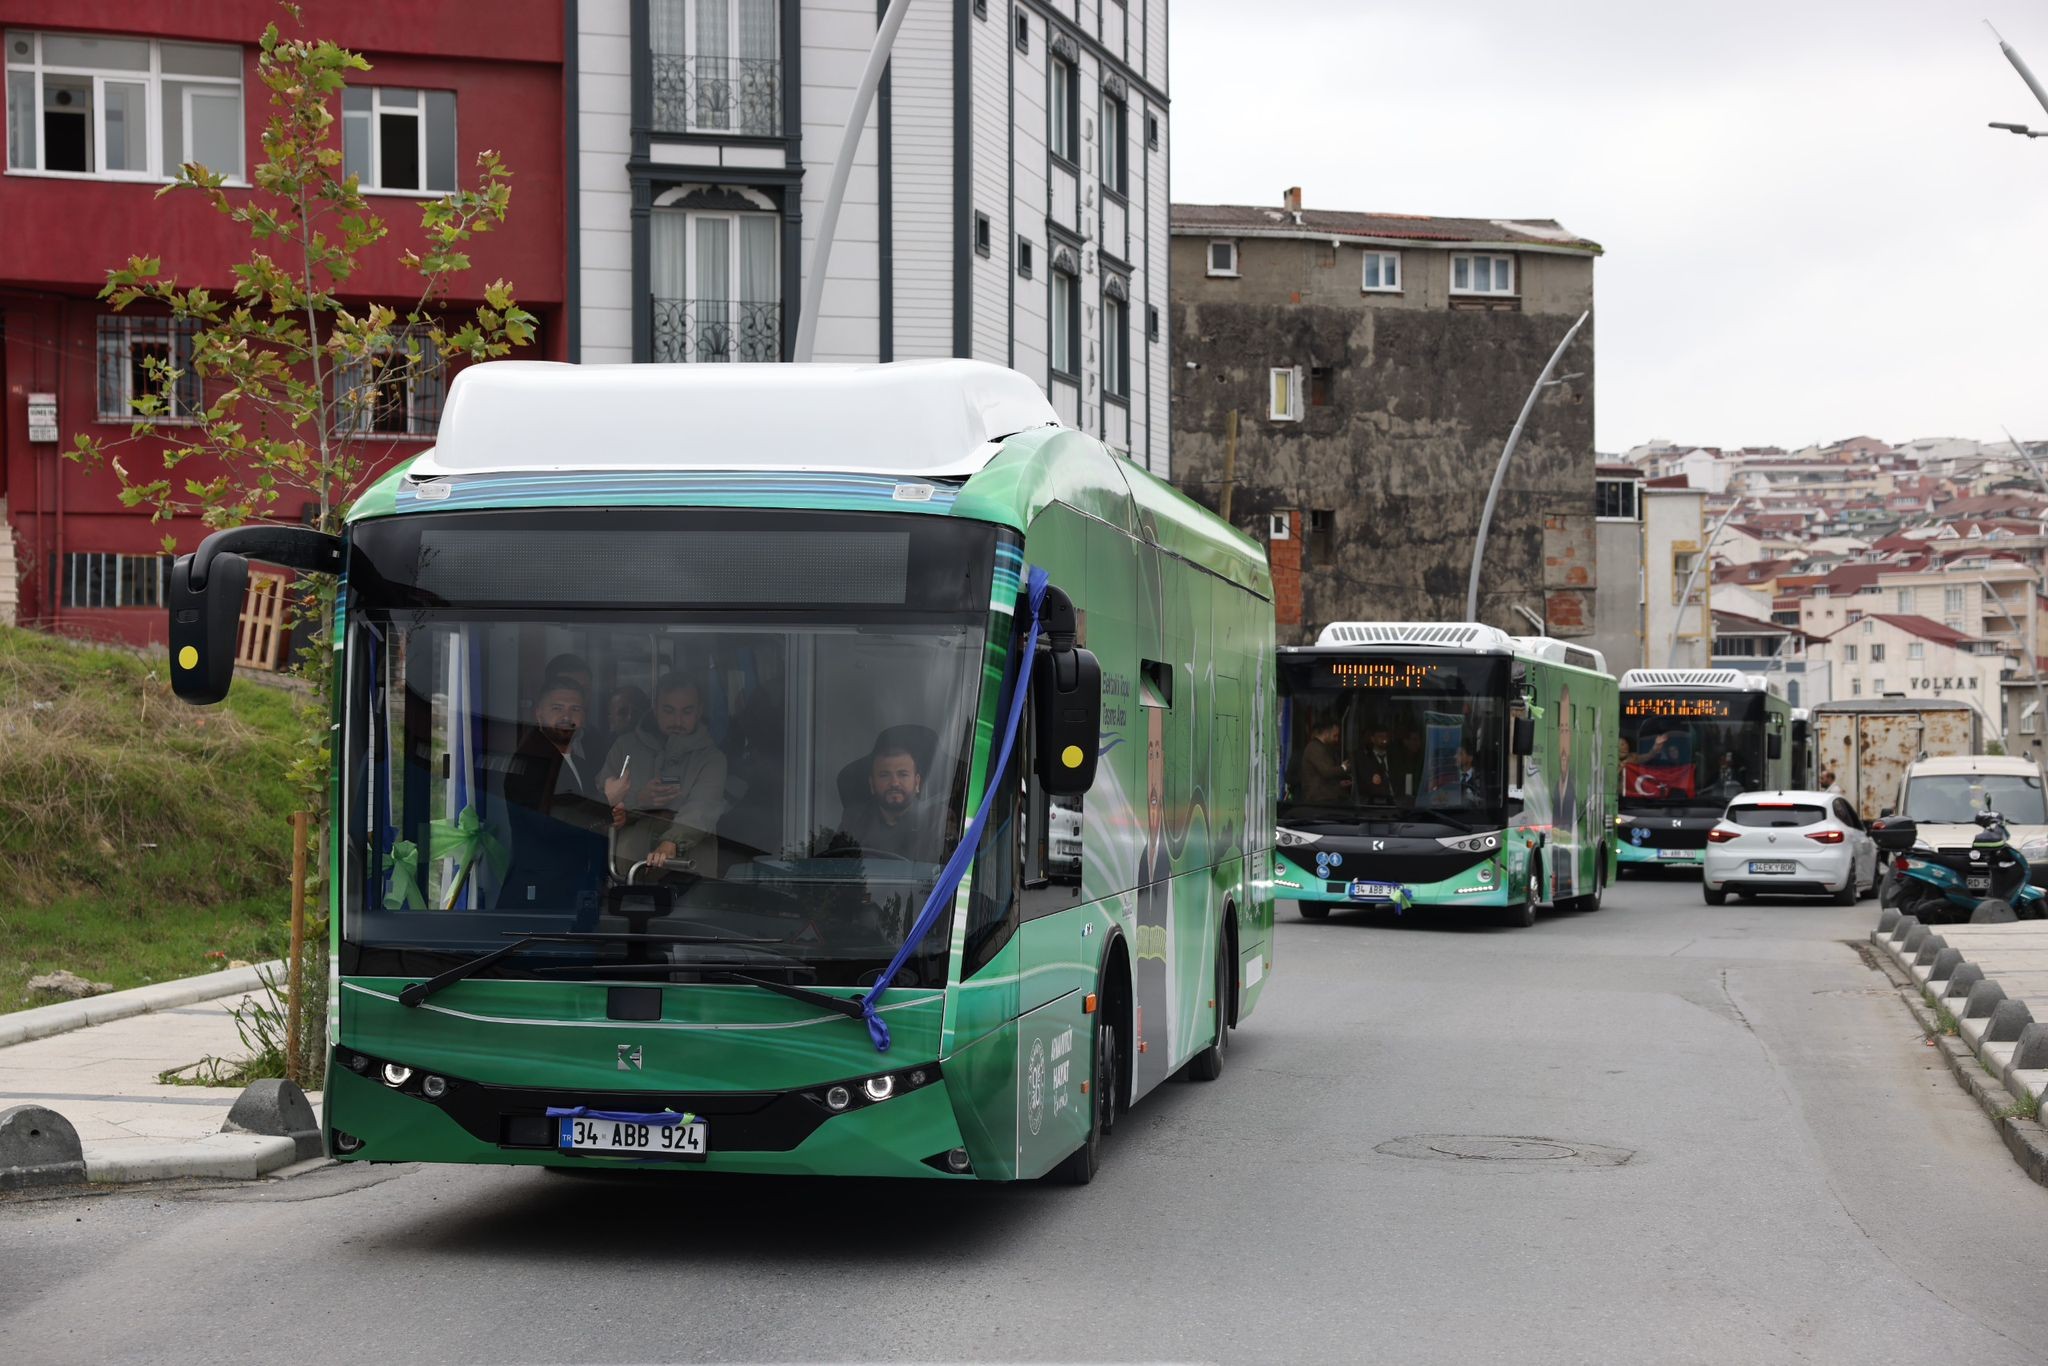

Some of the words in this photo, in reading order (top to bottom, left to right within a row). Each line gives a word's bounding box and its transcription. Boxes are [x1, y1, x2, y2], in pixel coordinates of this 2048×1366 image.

[1910, 677, 1978, 690] VOLKAN
[1356, 885, 1365, 894] 34
[1369, 885, 1384, 894] ABB
[562, 1134, 572, 1142] TR
[574, 1121, 598, 1145] 34
[612, 1123, 649, 1147] ABB
[661, 1126, 699, 1150] 924
